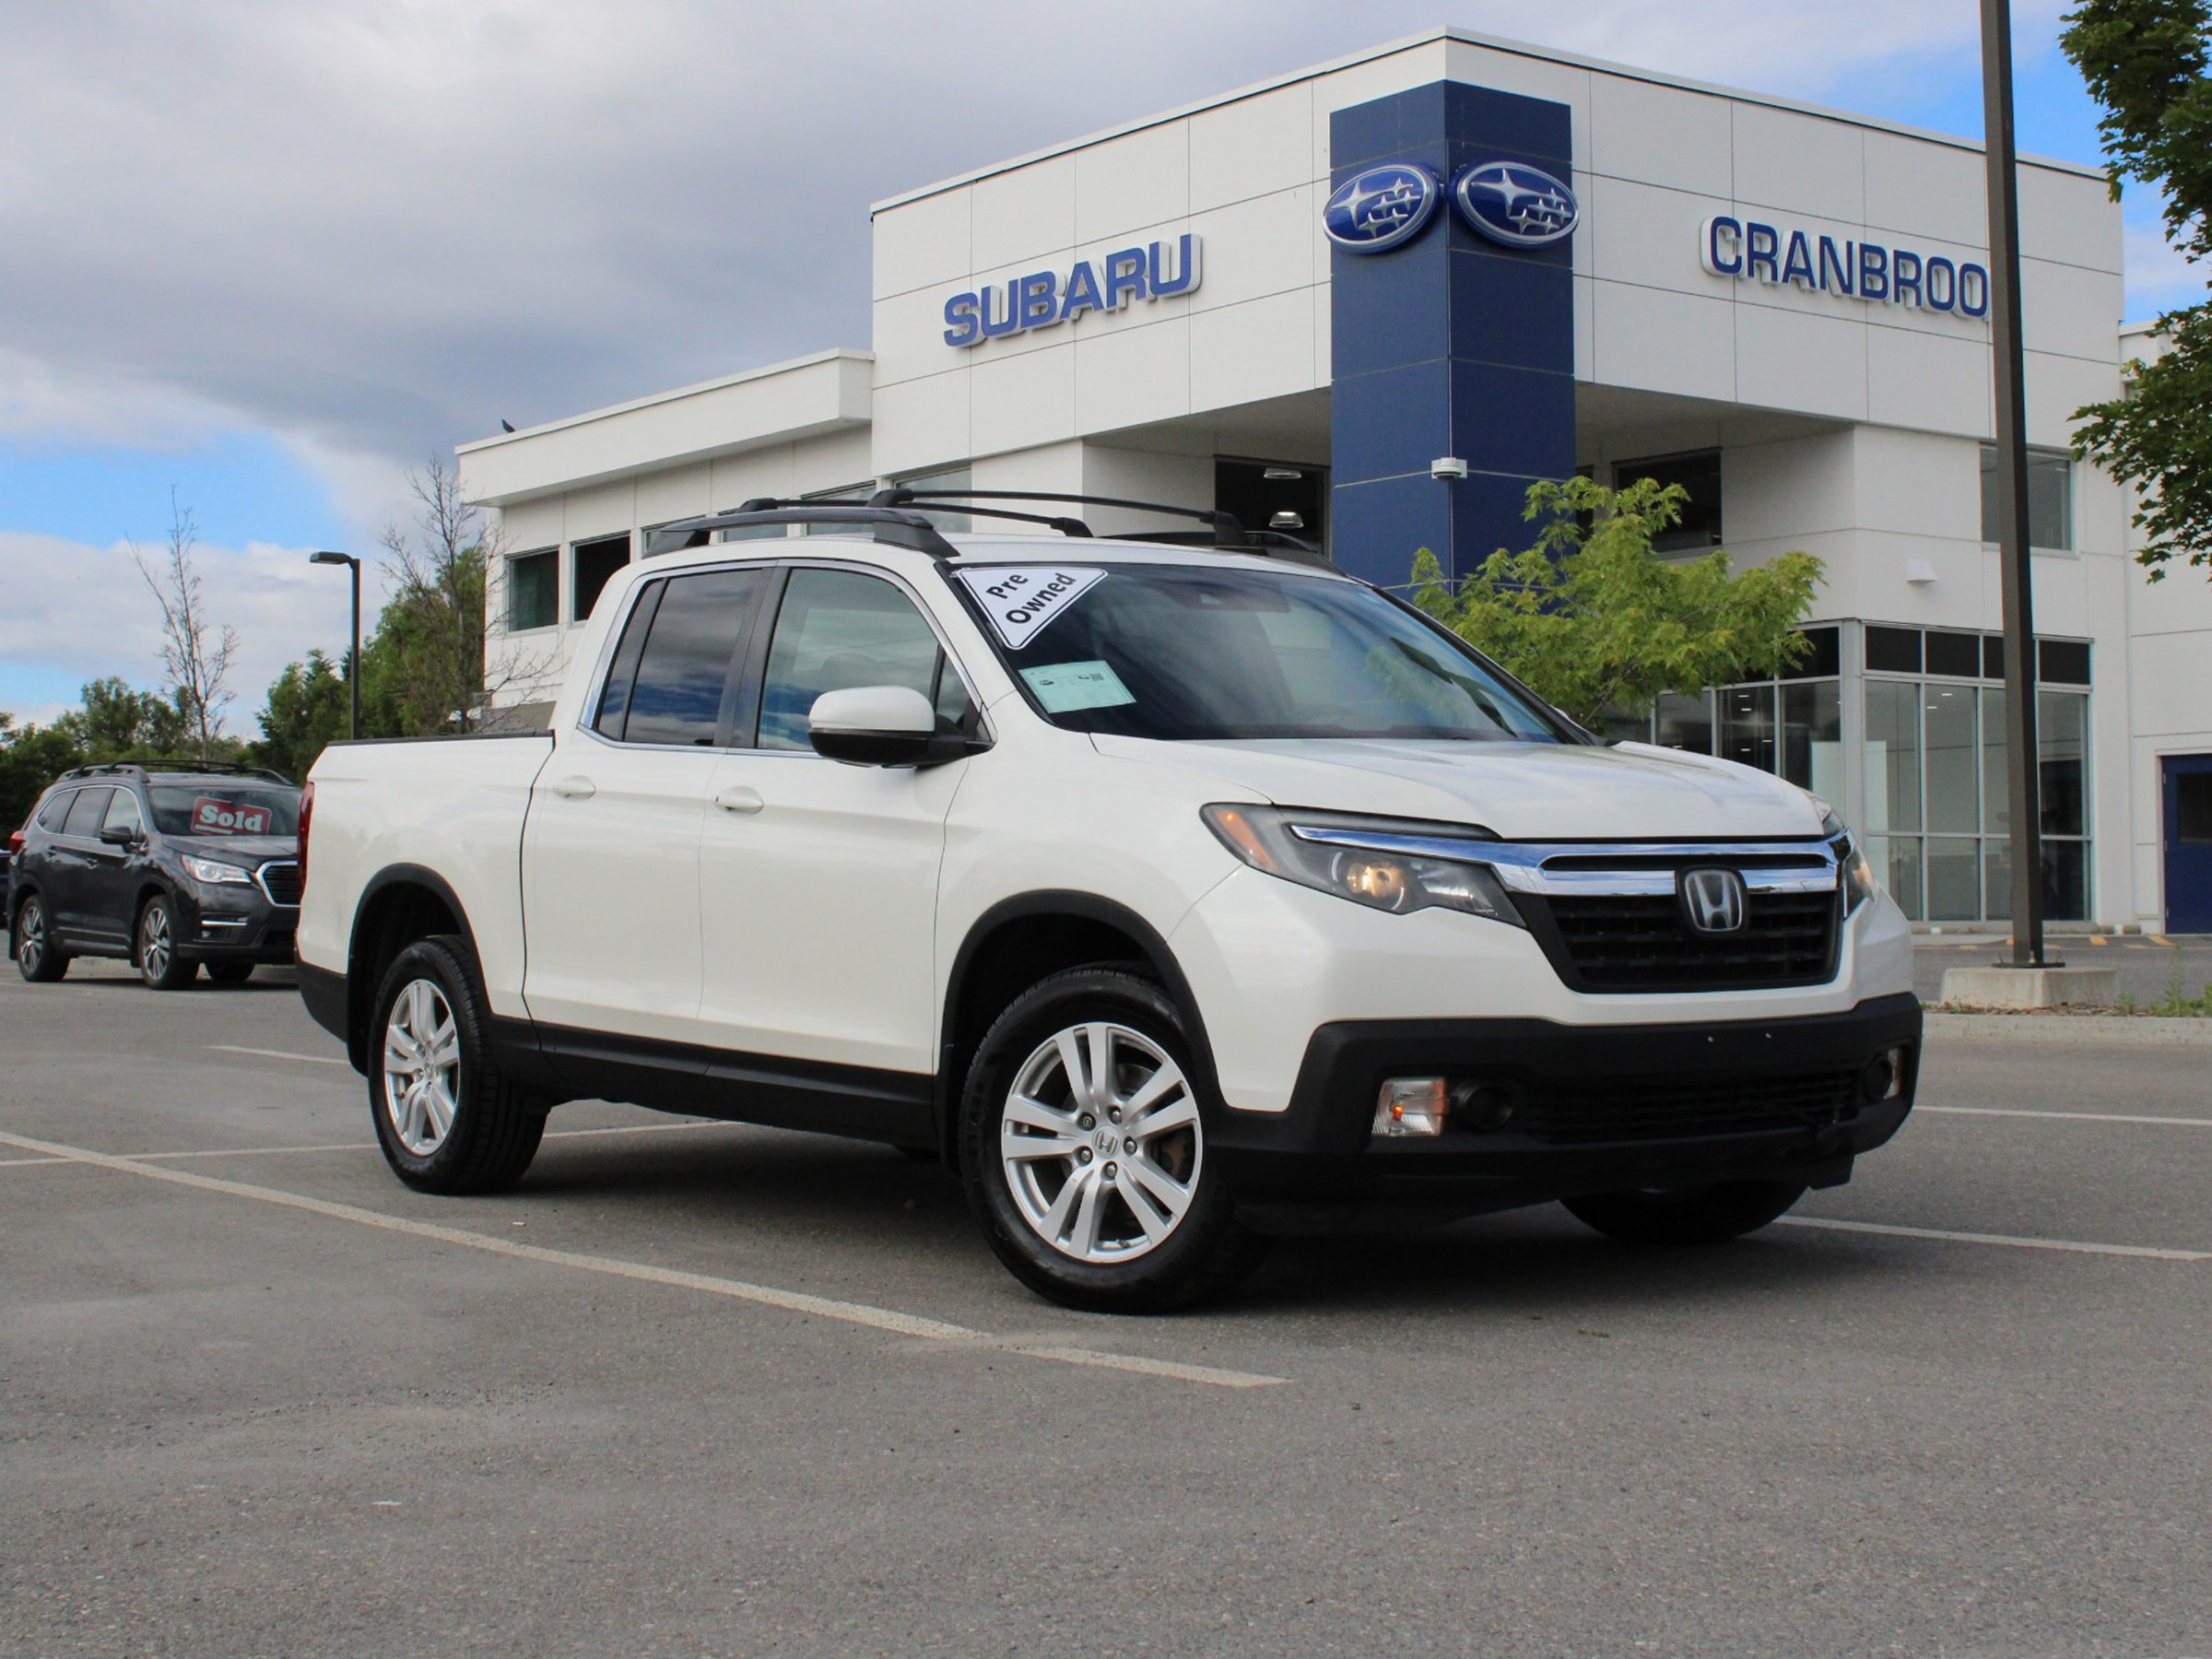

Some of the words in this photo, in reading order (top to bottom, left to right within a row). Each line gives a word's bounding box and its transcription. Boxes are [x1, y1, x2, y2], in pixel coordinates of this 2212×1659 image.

[944, 233, 1197, 348] SUBARU
[1706, 216, 1989, 319] CRANBROO
[985, 574, 1029, 599] Pre
[1006, 572, 1077, 624] Owned
[199, 805, 264, 832] Sold
